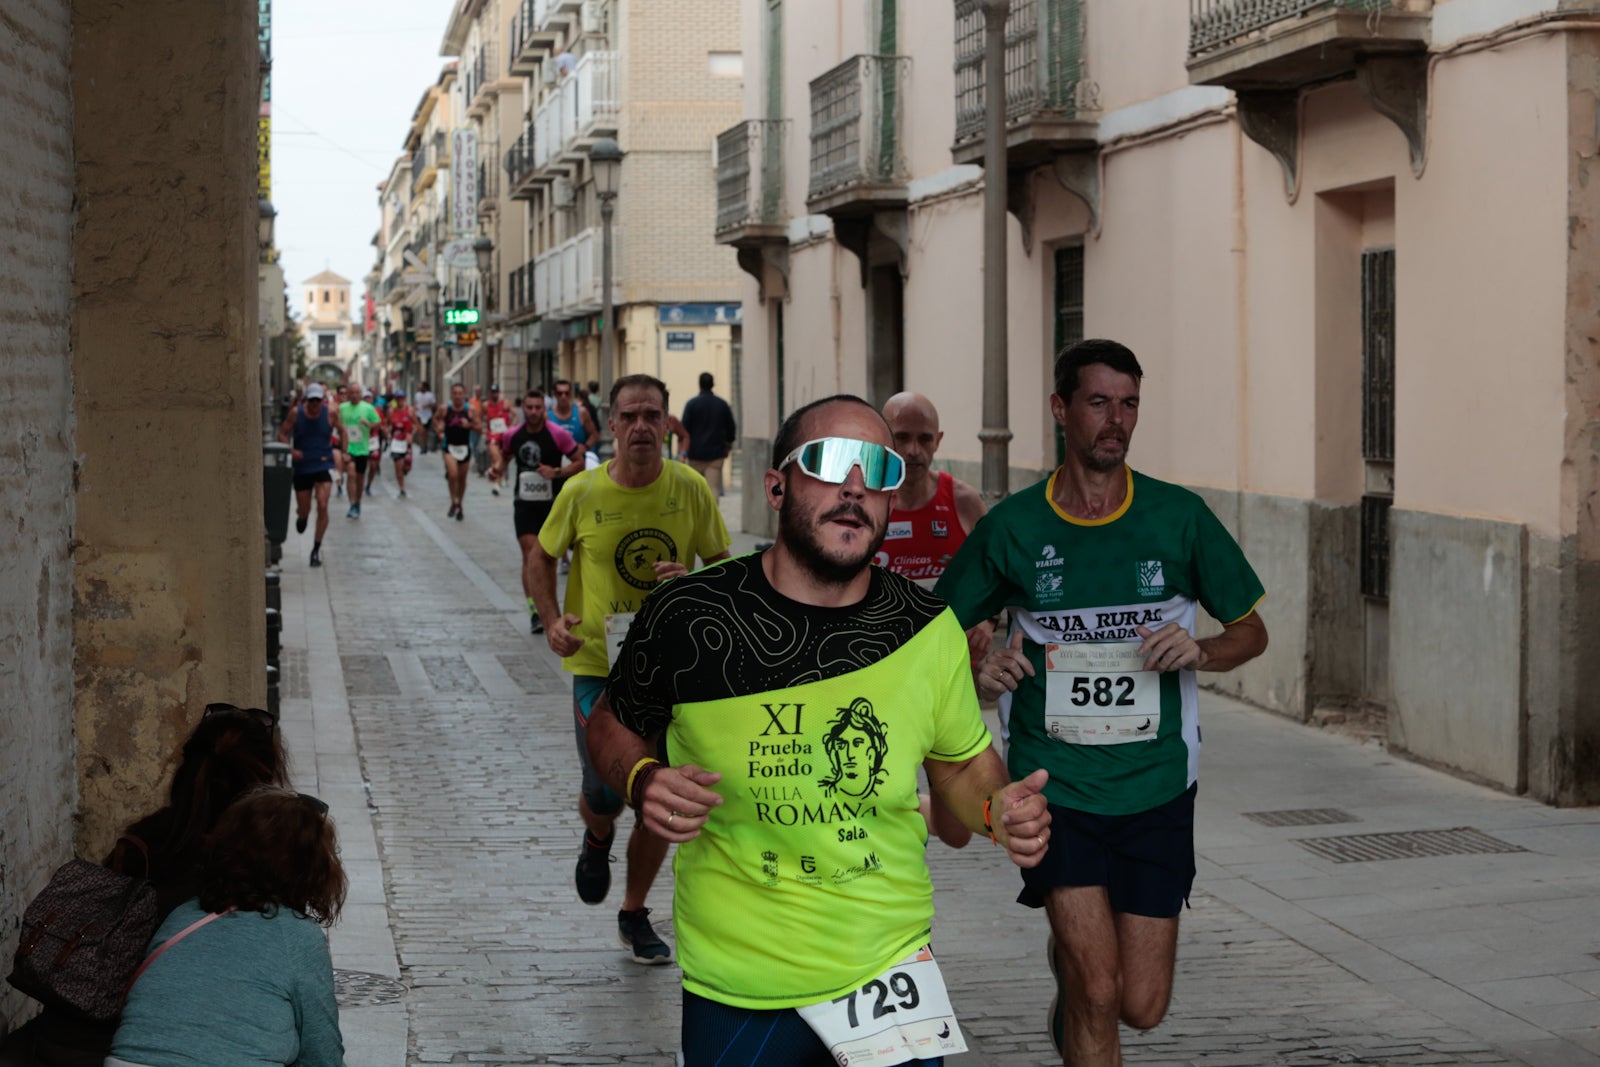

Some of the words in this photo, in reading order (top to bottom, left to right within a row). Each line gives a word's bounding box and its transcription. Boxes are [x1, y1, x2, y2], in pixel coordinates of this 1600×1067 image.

[465, 133, 474, 229] PIONONOS
[1035, 558, 1064, 568] VIATOR
[1036, 615, 1087, 632] CAJA
[1062, 628, 1138, 642] GRANADA
[1071, 676, 1135, 707] 582
[759, 703, 806, 736] XI
[748, 739, 812, 756] Prueba
[748, 758, 812, 778] Fondo
[749, 786, 803, 800] VILLA
[755, 802, 877, 826] ROMANA
[832, 972, 920, 1029] 729
